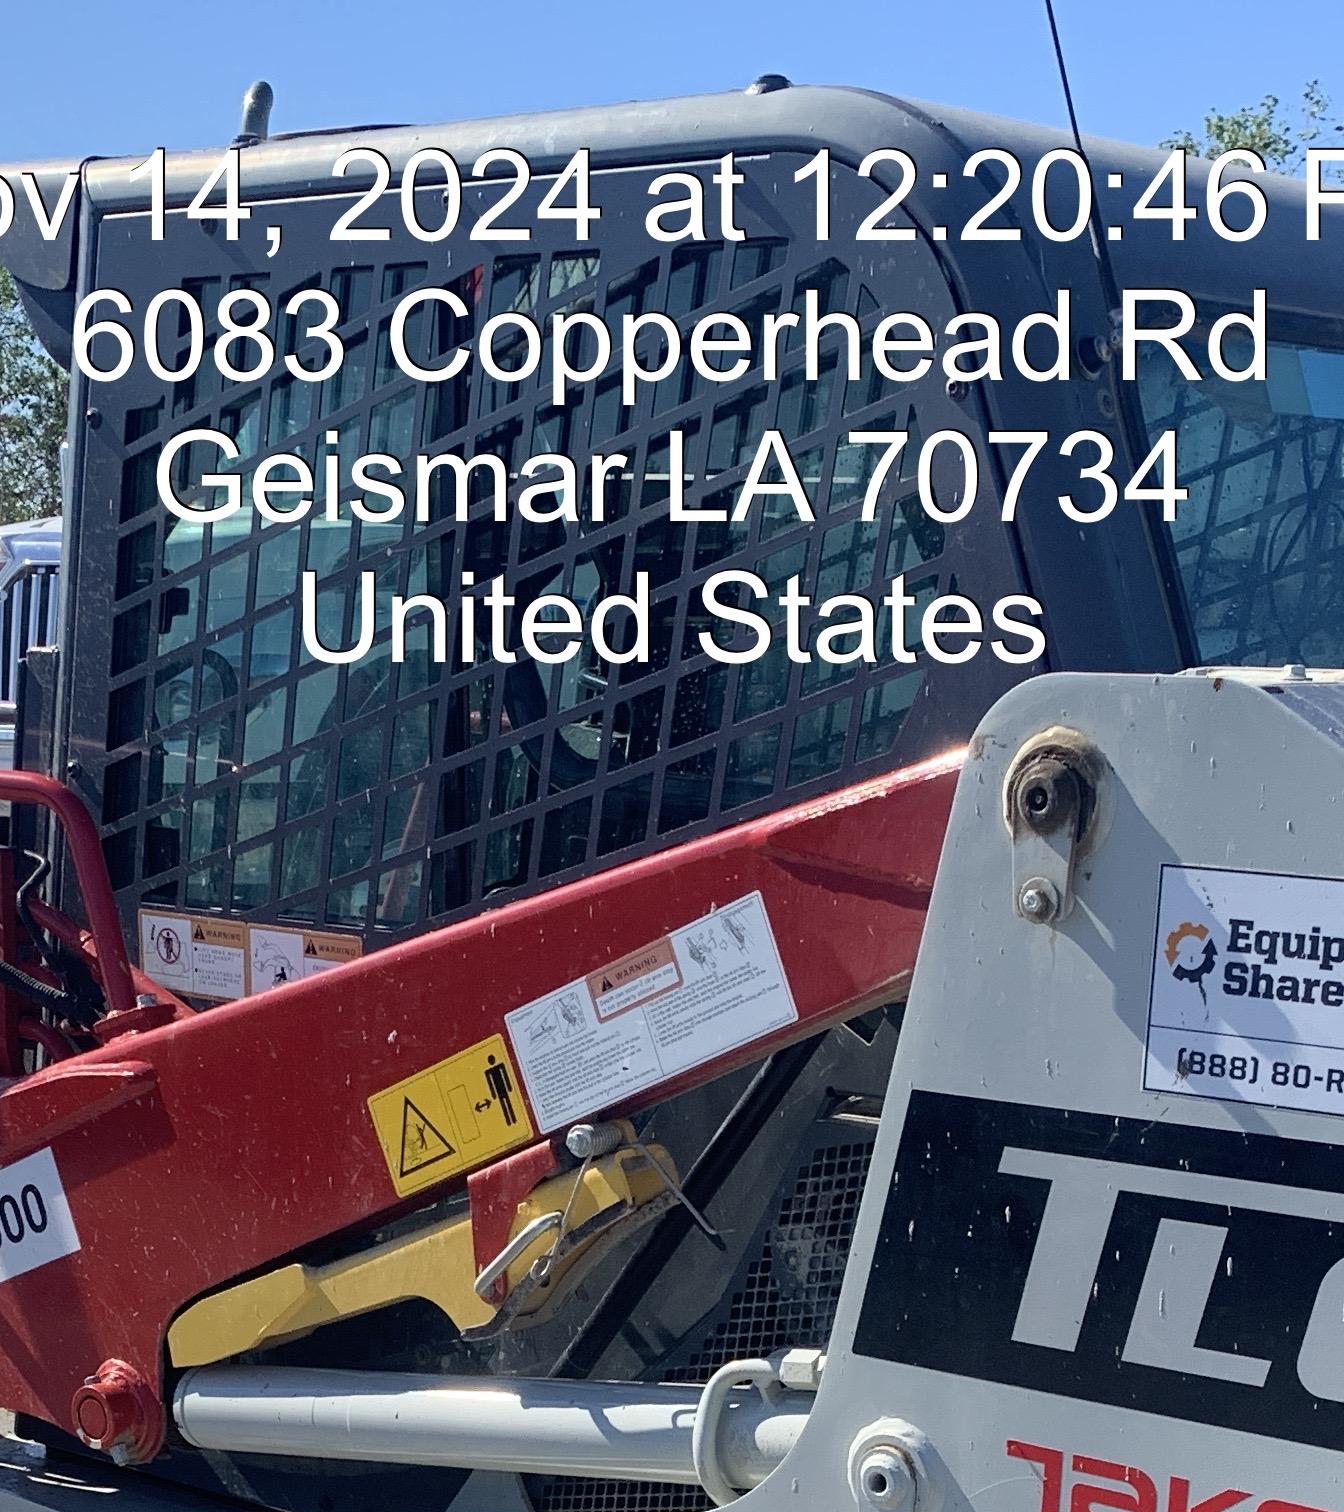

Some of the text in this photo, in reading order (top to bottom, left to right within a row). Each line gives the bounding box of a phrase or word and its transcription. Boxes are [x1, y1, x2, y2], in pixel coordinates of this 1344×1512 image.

[614, 954, 659, 981] WARNING
[1222, 962, 1344, 1007] Share
[1177, 1047, 1259, 1084] (888)
